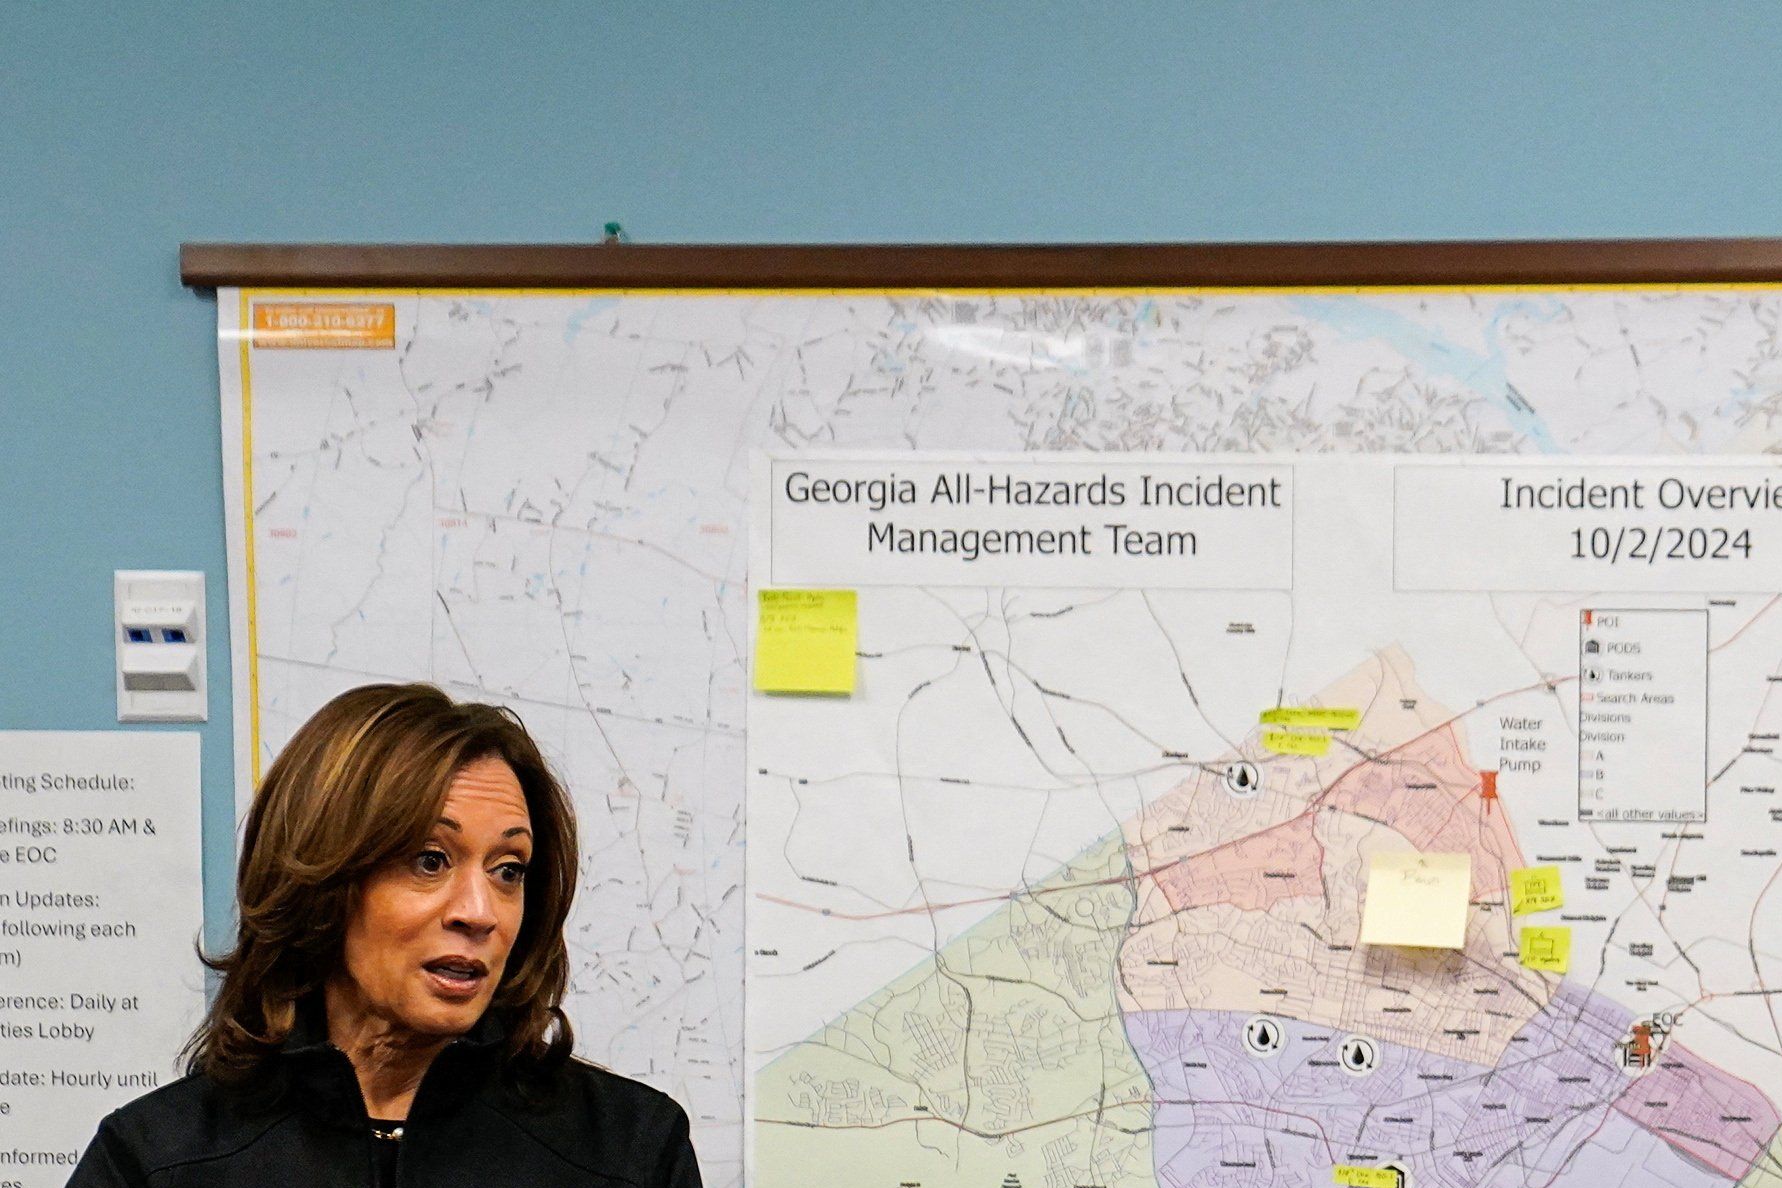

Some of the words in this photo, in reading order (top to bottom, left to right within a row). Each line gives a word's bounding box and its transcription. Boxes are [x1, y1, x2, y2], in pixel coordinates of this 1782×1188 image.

[785, 472, 917, 511] Georgia
[931, 473, 1126, 506] All-Hazards
[1141, 475, 1282, 508] Incident
[1501, 478, 1644, 510] Incident
[868, 522, 1091, 562] Management
[1104, 524, 1197, 556] Team
[1570, 526, 1753, 563] 10/2/2024
[1607, 642, 1640, 654] PODS
[1609, 669, 1652, 681] Tankers
[1597, 693, 1636, 704] Search
[1641, 693, 1674, 704] Areas
[1500, 716, 1543, 731] Water
[1580, 712, 1631, 723] Divisions
[1500, 737, 1546, 752] Intake
[1580, 731, 1624, 742] Division
[1596, 751, 1604, 761] A
[1500, 758, 1541, 774] Pump
[41, 773, 135, 791] Schedule:
[1596, 770, 1604, 780] B
[1595, 789, 1603, 799] C
[1623, 810, 1653, 820] other
[63, 818, 103, 835] 8:30
[108, 818, 137, 834] AM
[143, 818, 156, 835] &
[16, 846, 57, 863] EOC
[16, 890, 99, 910] Updates:
[2, 919, 86, 940] following
[91, 921, 136, 937] each
[70, 994, 116, 1012] Daily
[122, 996, 138, 1010] at
[38, 1022, 94, 1041] Lobby
[51, 1070, 112, 1089] Hourly
[117, 1071, 158, 1087] until
